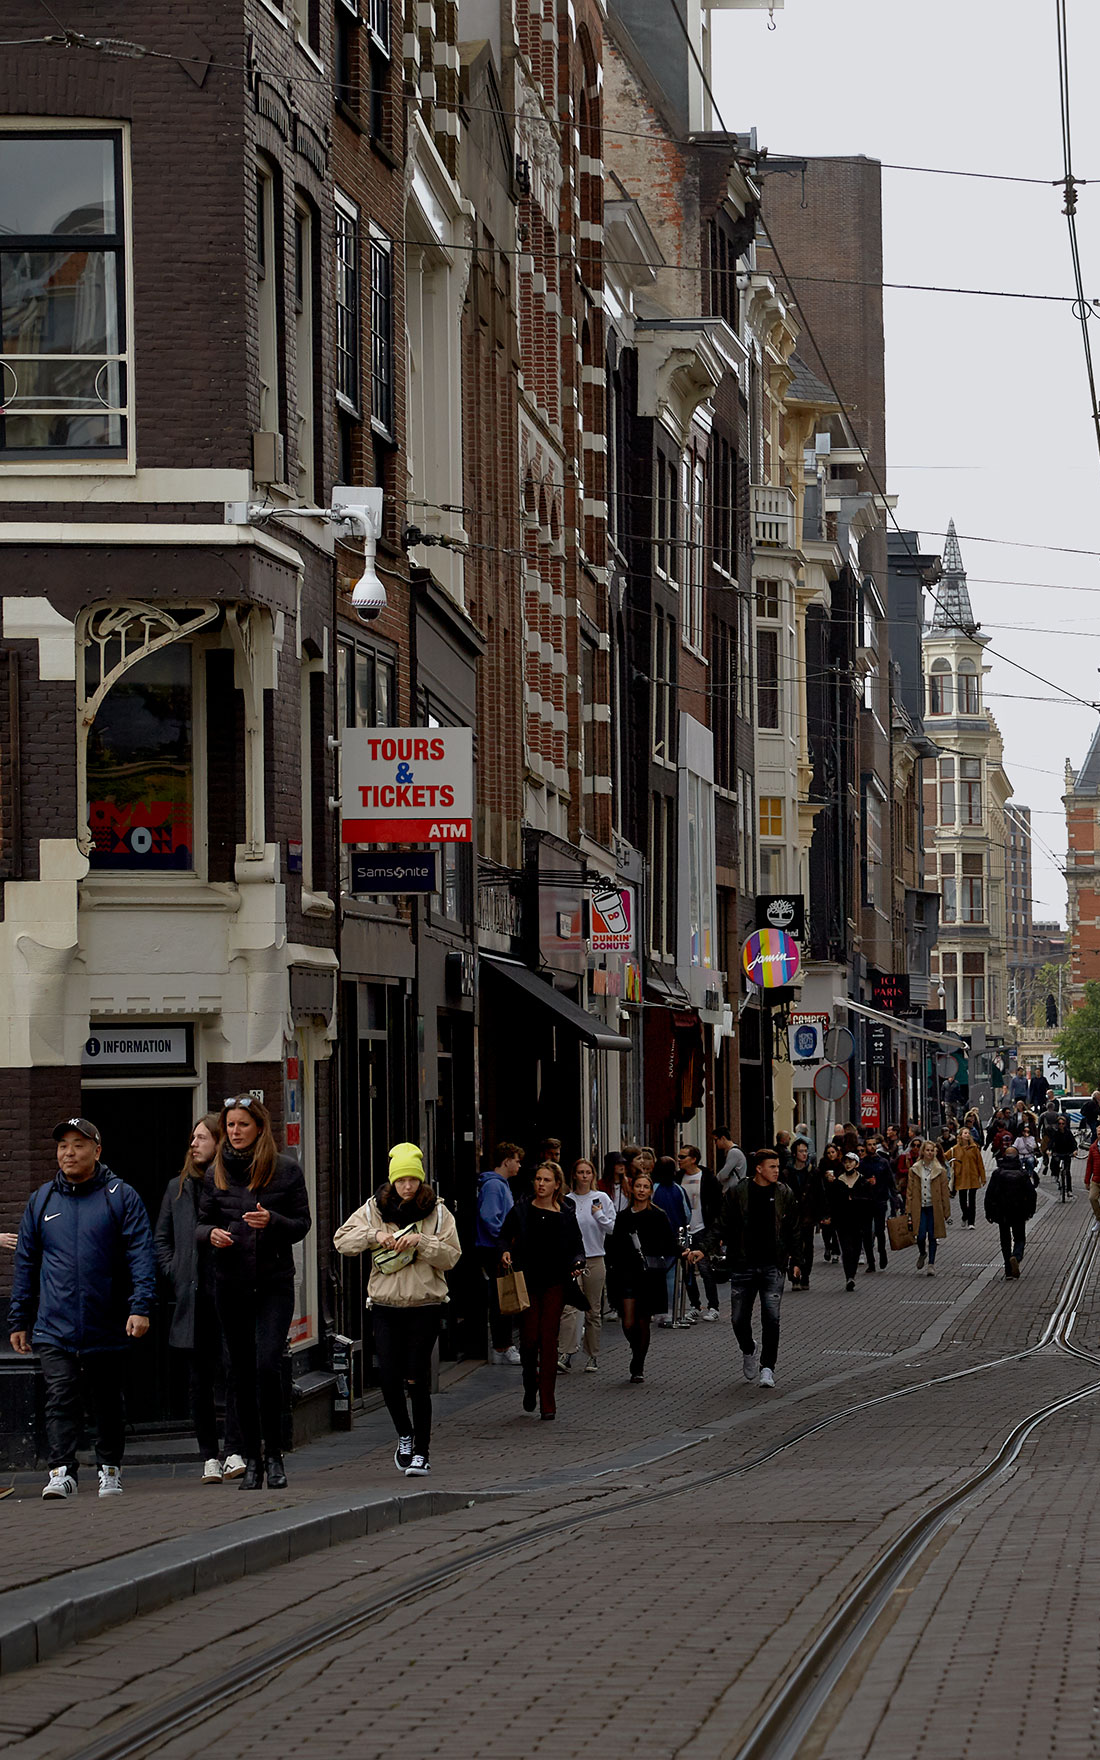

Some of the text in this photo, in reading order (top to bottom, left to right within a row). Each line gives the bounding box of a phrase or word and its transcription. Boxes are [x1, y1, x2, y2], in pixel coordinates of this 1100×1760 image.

[367, 738, 445, 760] TOURS
[395, 762, 414, 784] &
[358, 785, 454, 807] TICKETS
[428, 823, 467, 838] ATM
[357, 866, 429, 879] Samsonite
[592, 934, 632, 942] DUNKIN'
[592, 942, 630, 950] DONUTS
[880, 976, 896, 985] ICI
[873, 987, 903, 997] PARIS
[103, 1039, 172, 1054] INFORMATION
